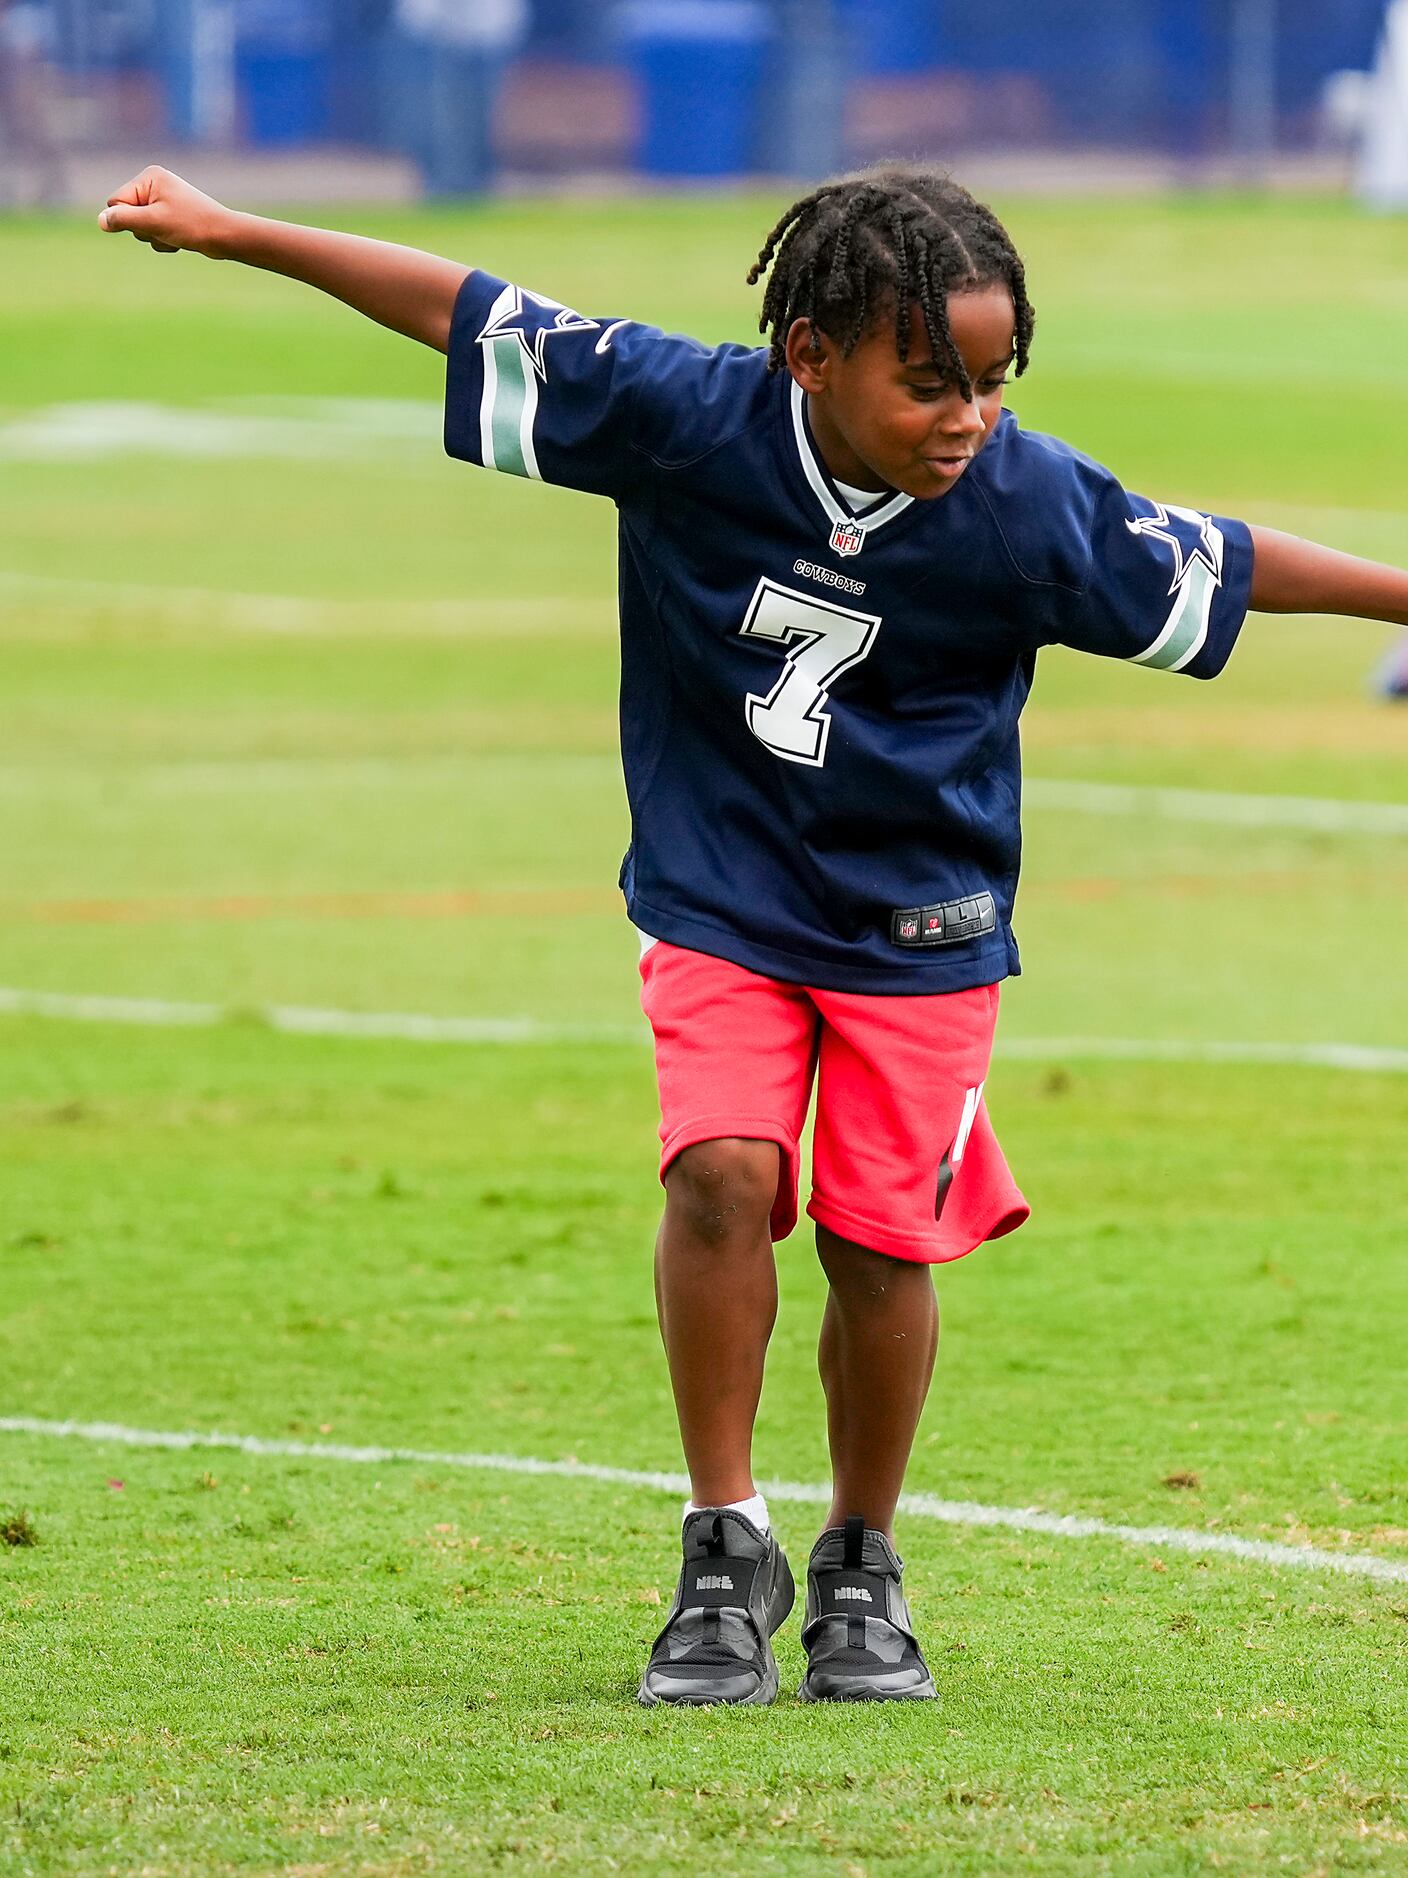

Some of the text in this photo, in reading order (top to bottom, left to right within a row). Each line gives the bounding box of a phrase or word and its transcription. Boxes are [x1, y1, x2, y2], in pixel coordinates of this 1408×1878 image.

[834, 533, 858, 551] NFL
[793, 559, 867, 595] COWBOYS
[738, 575, 883, 768] 7
[958, 906, 968, 920] L
[902, 927, 916, 936] NFL
[696, 1575, 734, 1590] NIKE
[834, 1587, 873, 1602] NIKE
